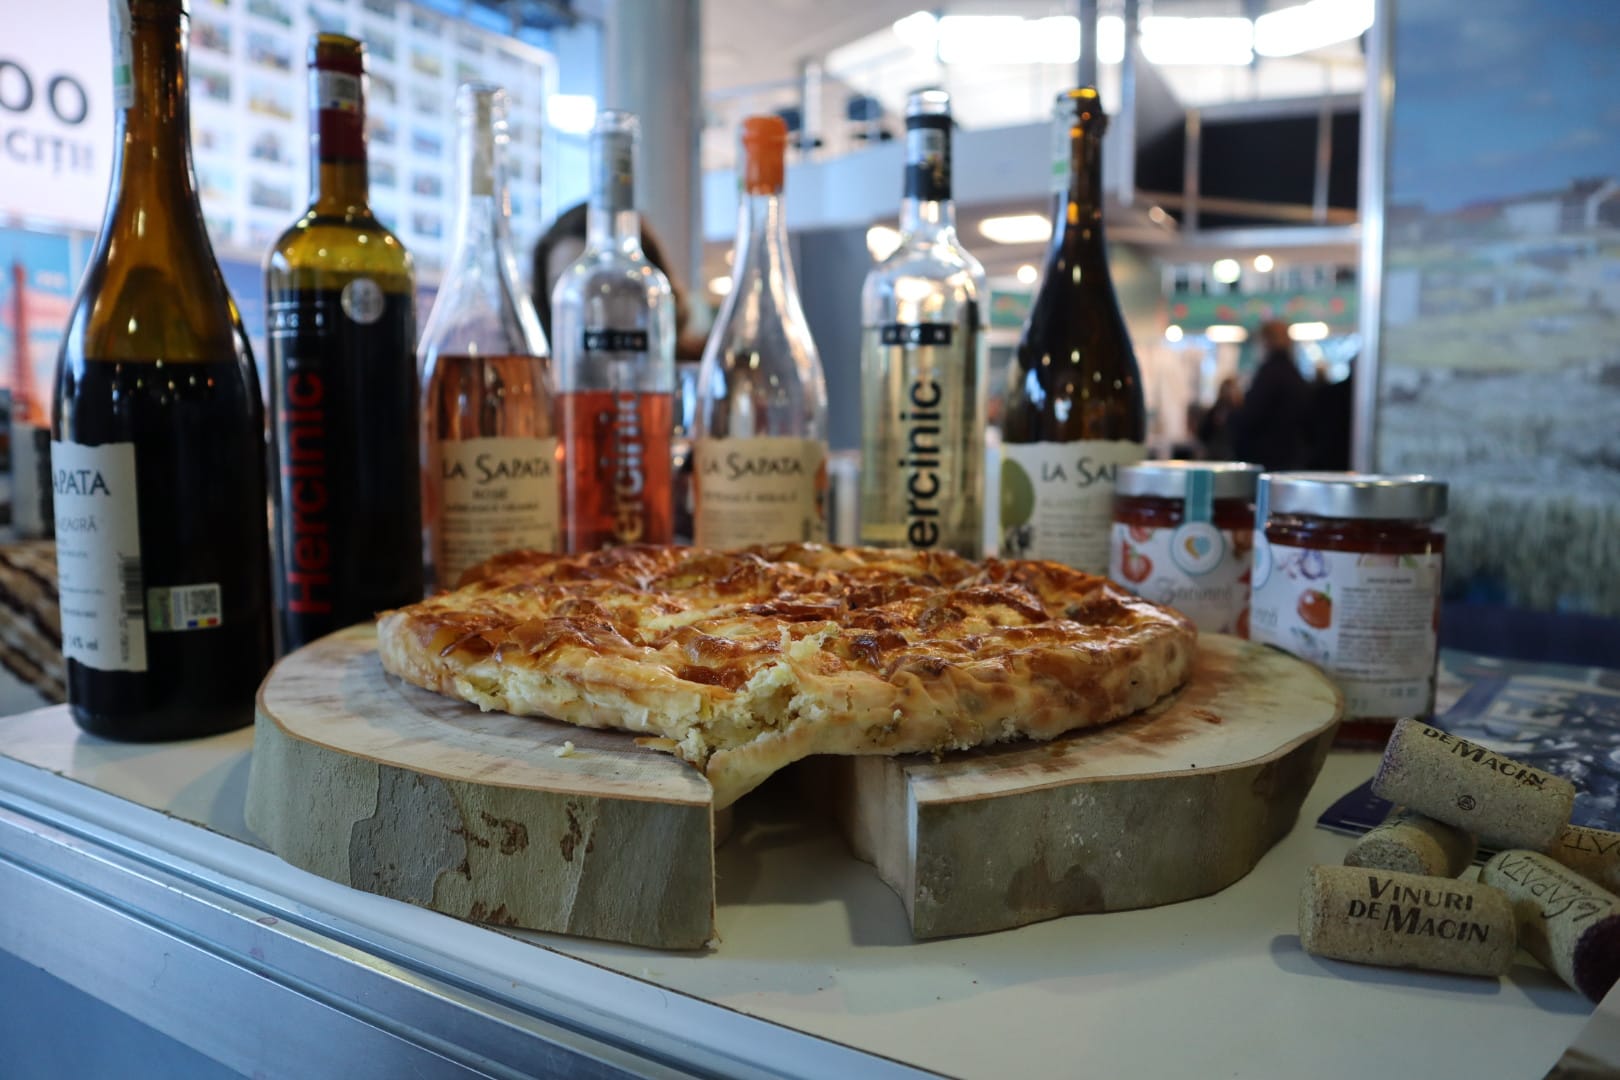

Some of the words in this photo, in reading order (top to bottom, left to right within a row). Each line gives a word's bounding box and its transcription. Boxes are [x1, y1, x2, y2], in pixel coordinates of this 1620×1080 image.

[1041, 461, 1067, 482] LA
[287, 372, 332, 615] Hercinic
[1368, 876, 1474, 912] VINURI
[1349, 900, 1382, 920] DE
[1384, 907, 1490, 944] MACIN
